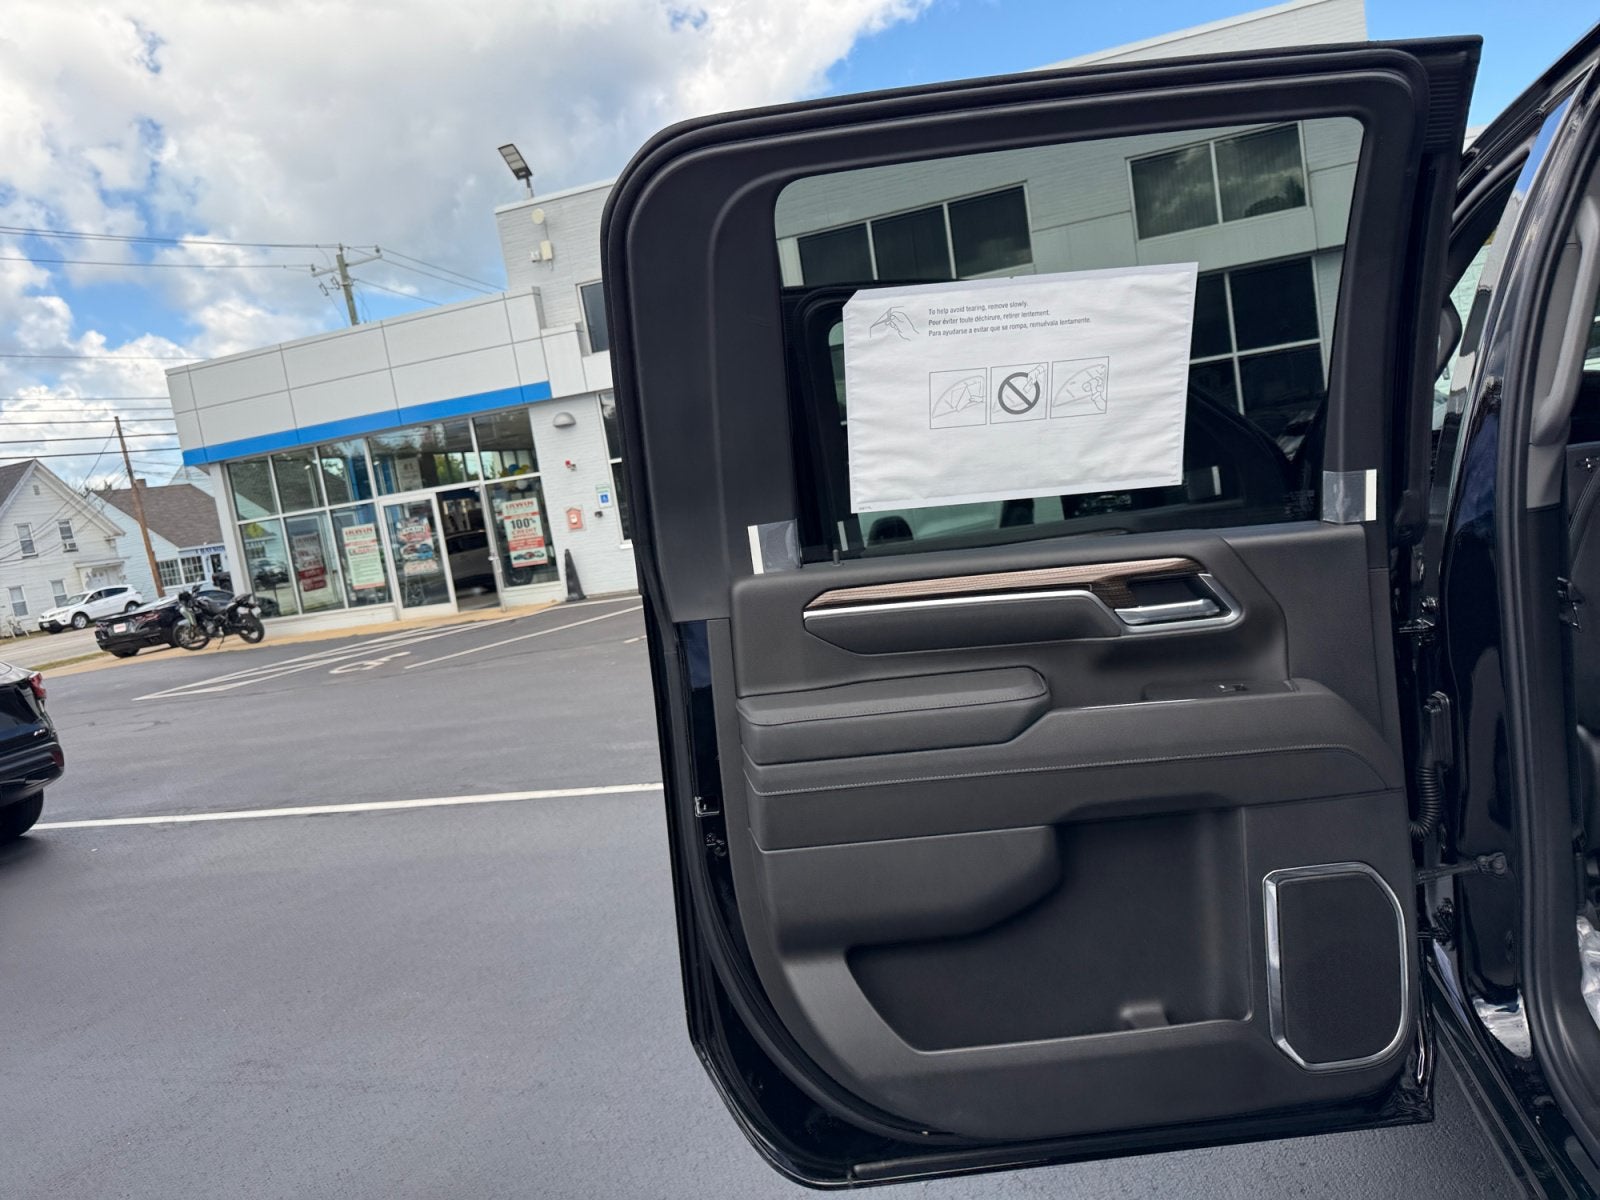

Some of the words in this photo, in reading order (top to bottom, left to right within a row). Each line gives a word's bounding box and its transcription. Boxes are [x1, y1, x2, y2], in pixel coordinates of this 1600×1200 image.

[966, 304, 987, 312] tearing,
[959, 316, 974, 324] toute
[942, 328, 968, 336] ayudarse
[1009, 323, 1028, 331] rompa,
[511, 517, 536, 530] 100%
